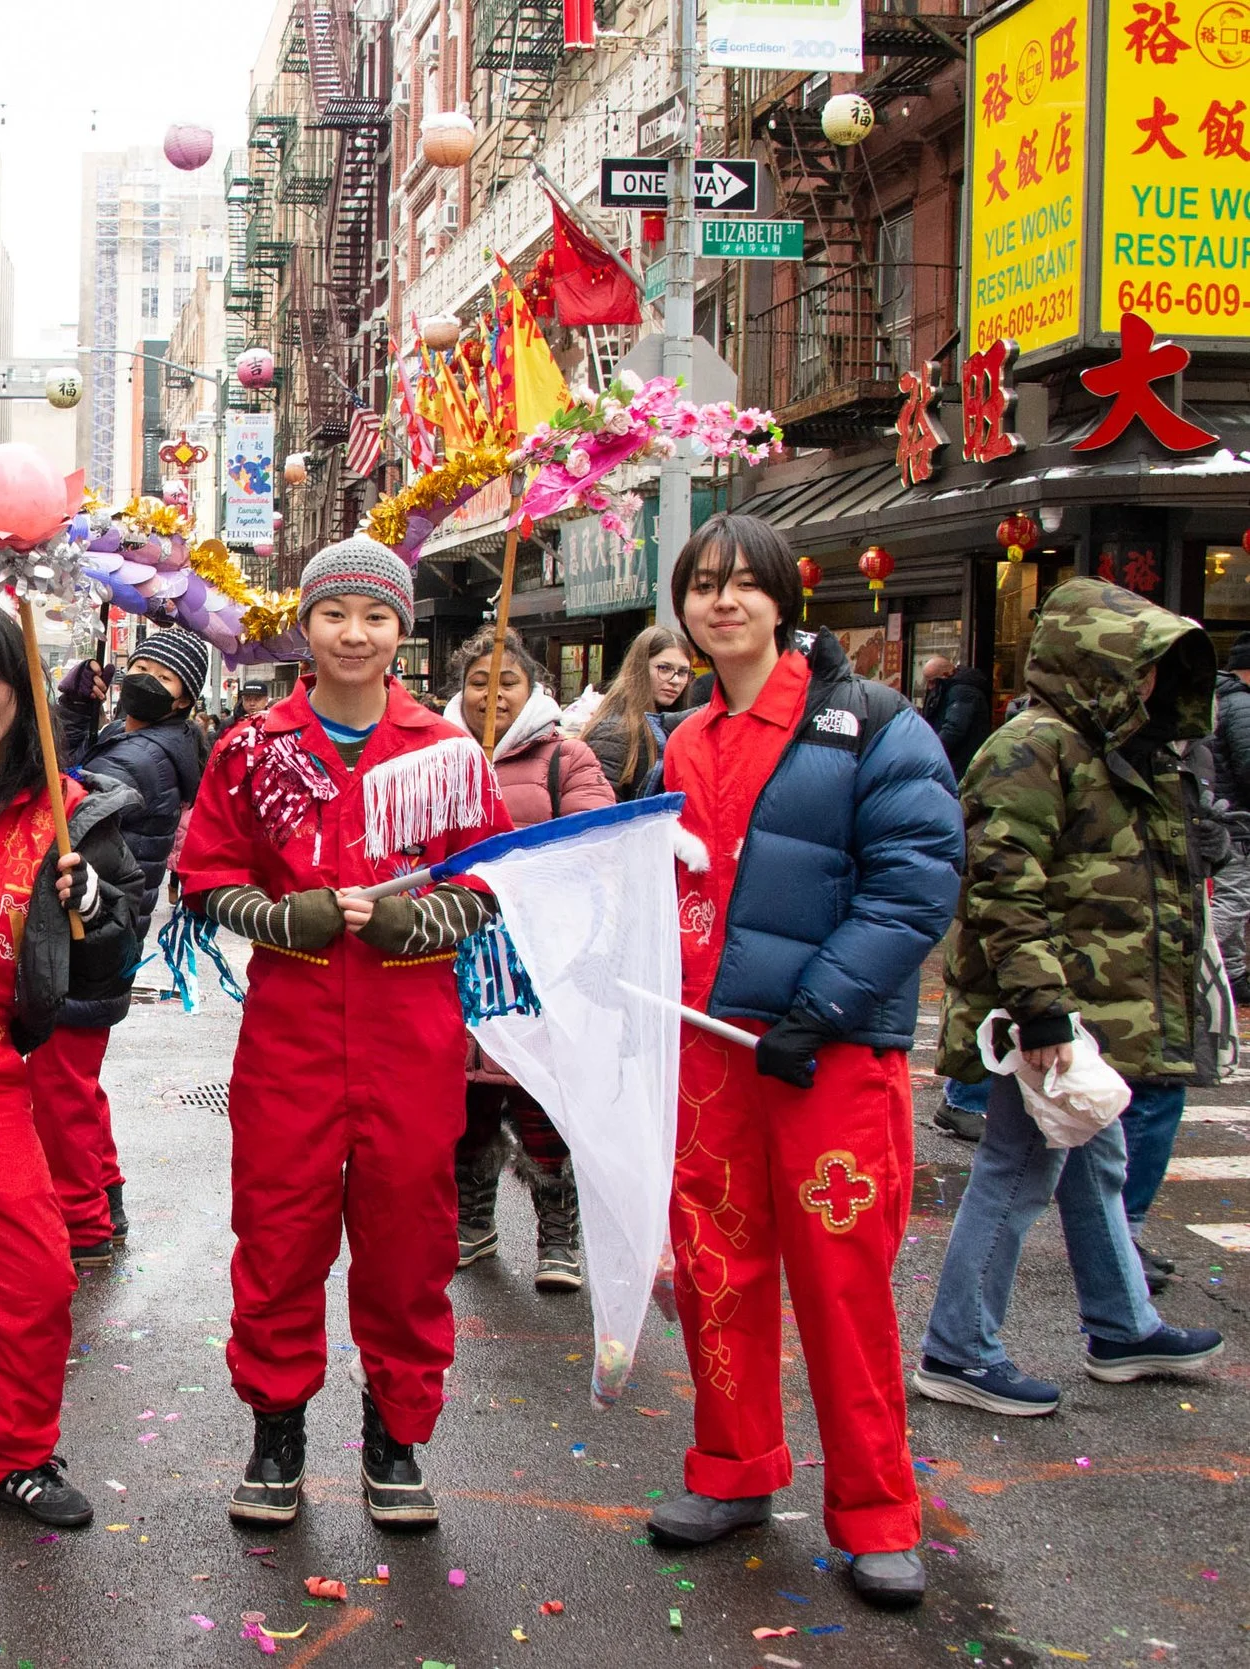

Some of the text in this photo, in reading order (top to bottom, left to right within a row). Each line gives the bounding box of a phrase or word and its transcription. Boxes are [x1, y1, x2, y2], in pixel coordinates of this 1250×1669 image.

[1124, 1, 1192, 64] 裕
[730, 42, 786, 54] conEdison
[792, 39, 837, 58] 200
[981, 16, 1080, 128] 裕 旺
[850, 100, 872, 127] 福
[645, 121, 661, 145] ONE
[984, 111, 1073, 208] 大飯店
[623, 174, 667, 194] ONE
[1132, 185, 1199, 220] YUE
[706, 222, 797, 244] ELIZABETH ST
[984, 195, 1073, 260] YUE WONG
[976, 239, 1077, 309] RESTAURANT
[977, 285, 1074, 350] 646-609-2331
[247, 357, 263, 376] 吉
[59, 379, 77, 397] 福
[1069, 312, 1221, 451] 大
[227, 530, 272, 538] FLUSHING
[236, 517, 265, 527] Together
[825, 708, 844, 719] THE
[816, 723, 841, 734] FACE
